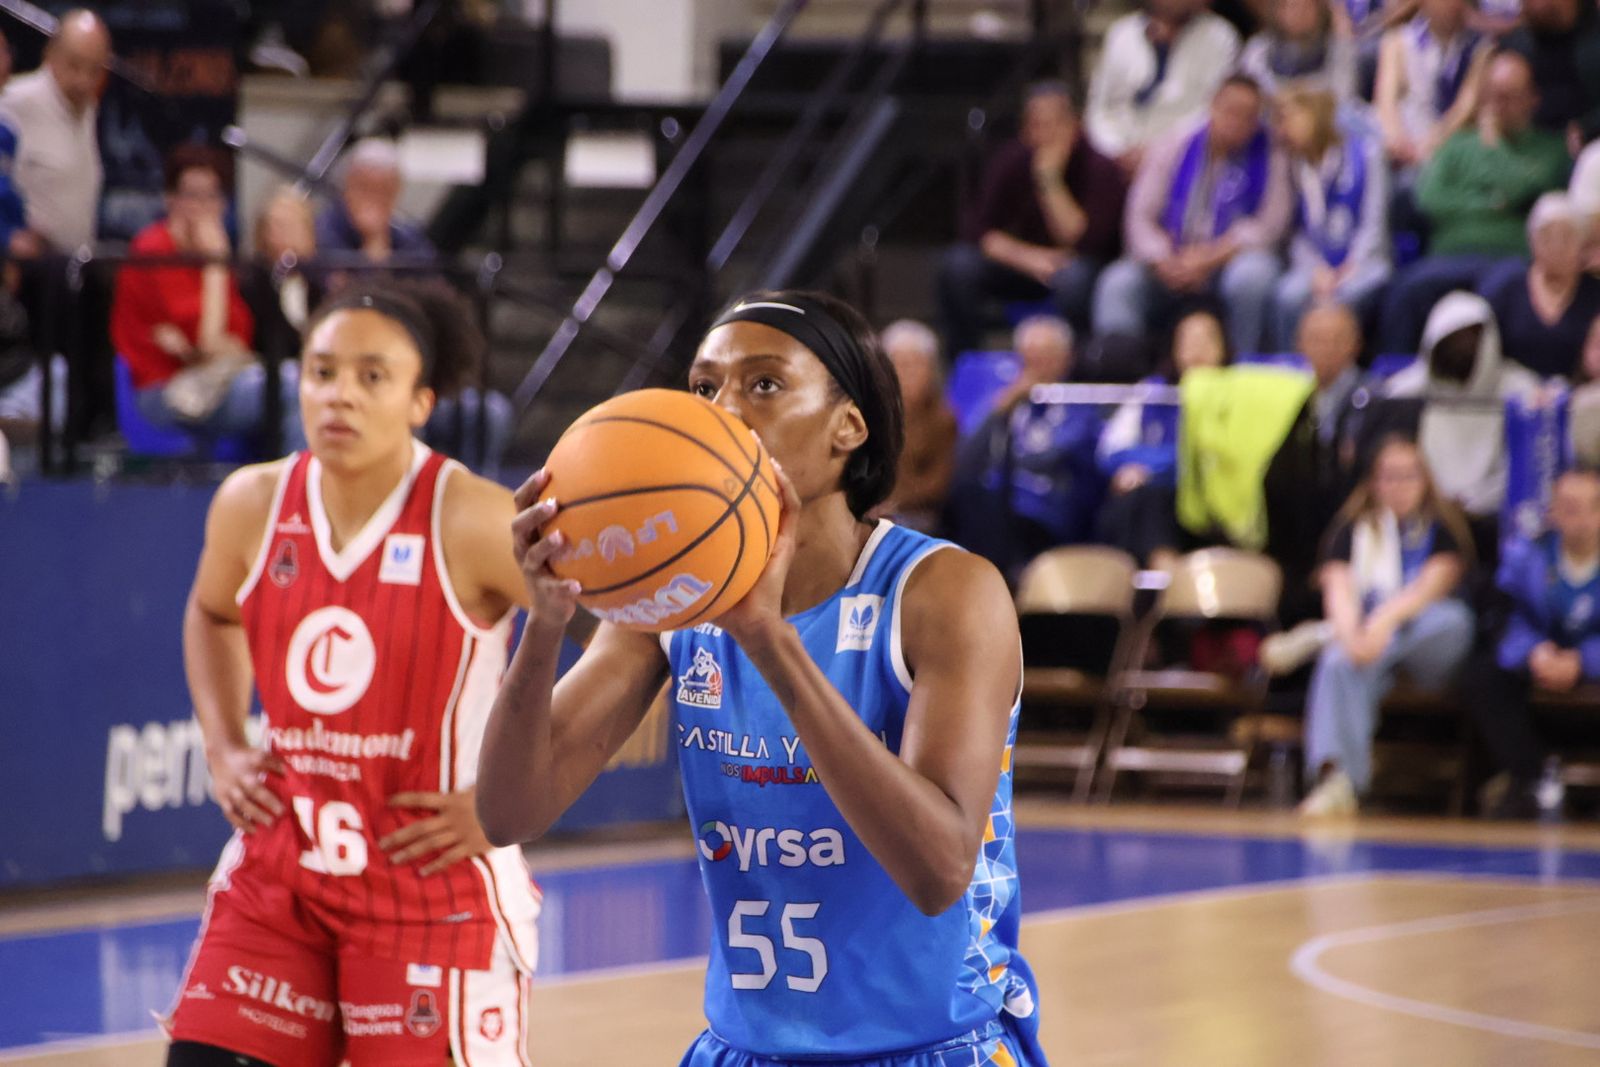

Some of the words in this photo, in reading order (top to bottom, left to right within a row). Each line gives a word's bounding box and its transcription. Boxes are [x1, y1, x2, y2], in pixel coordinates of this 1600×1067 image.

[679, 688, 721, 705] AVENID
[781, 736, 800, 764] Y
[292, 796, 369, 877] 16
[727, 900, 829, 993] 55
[221, 965, 337, 1023] Silken
